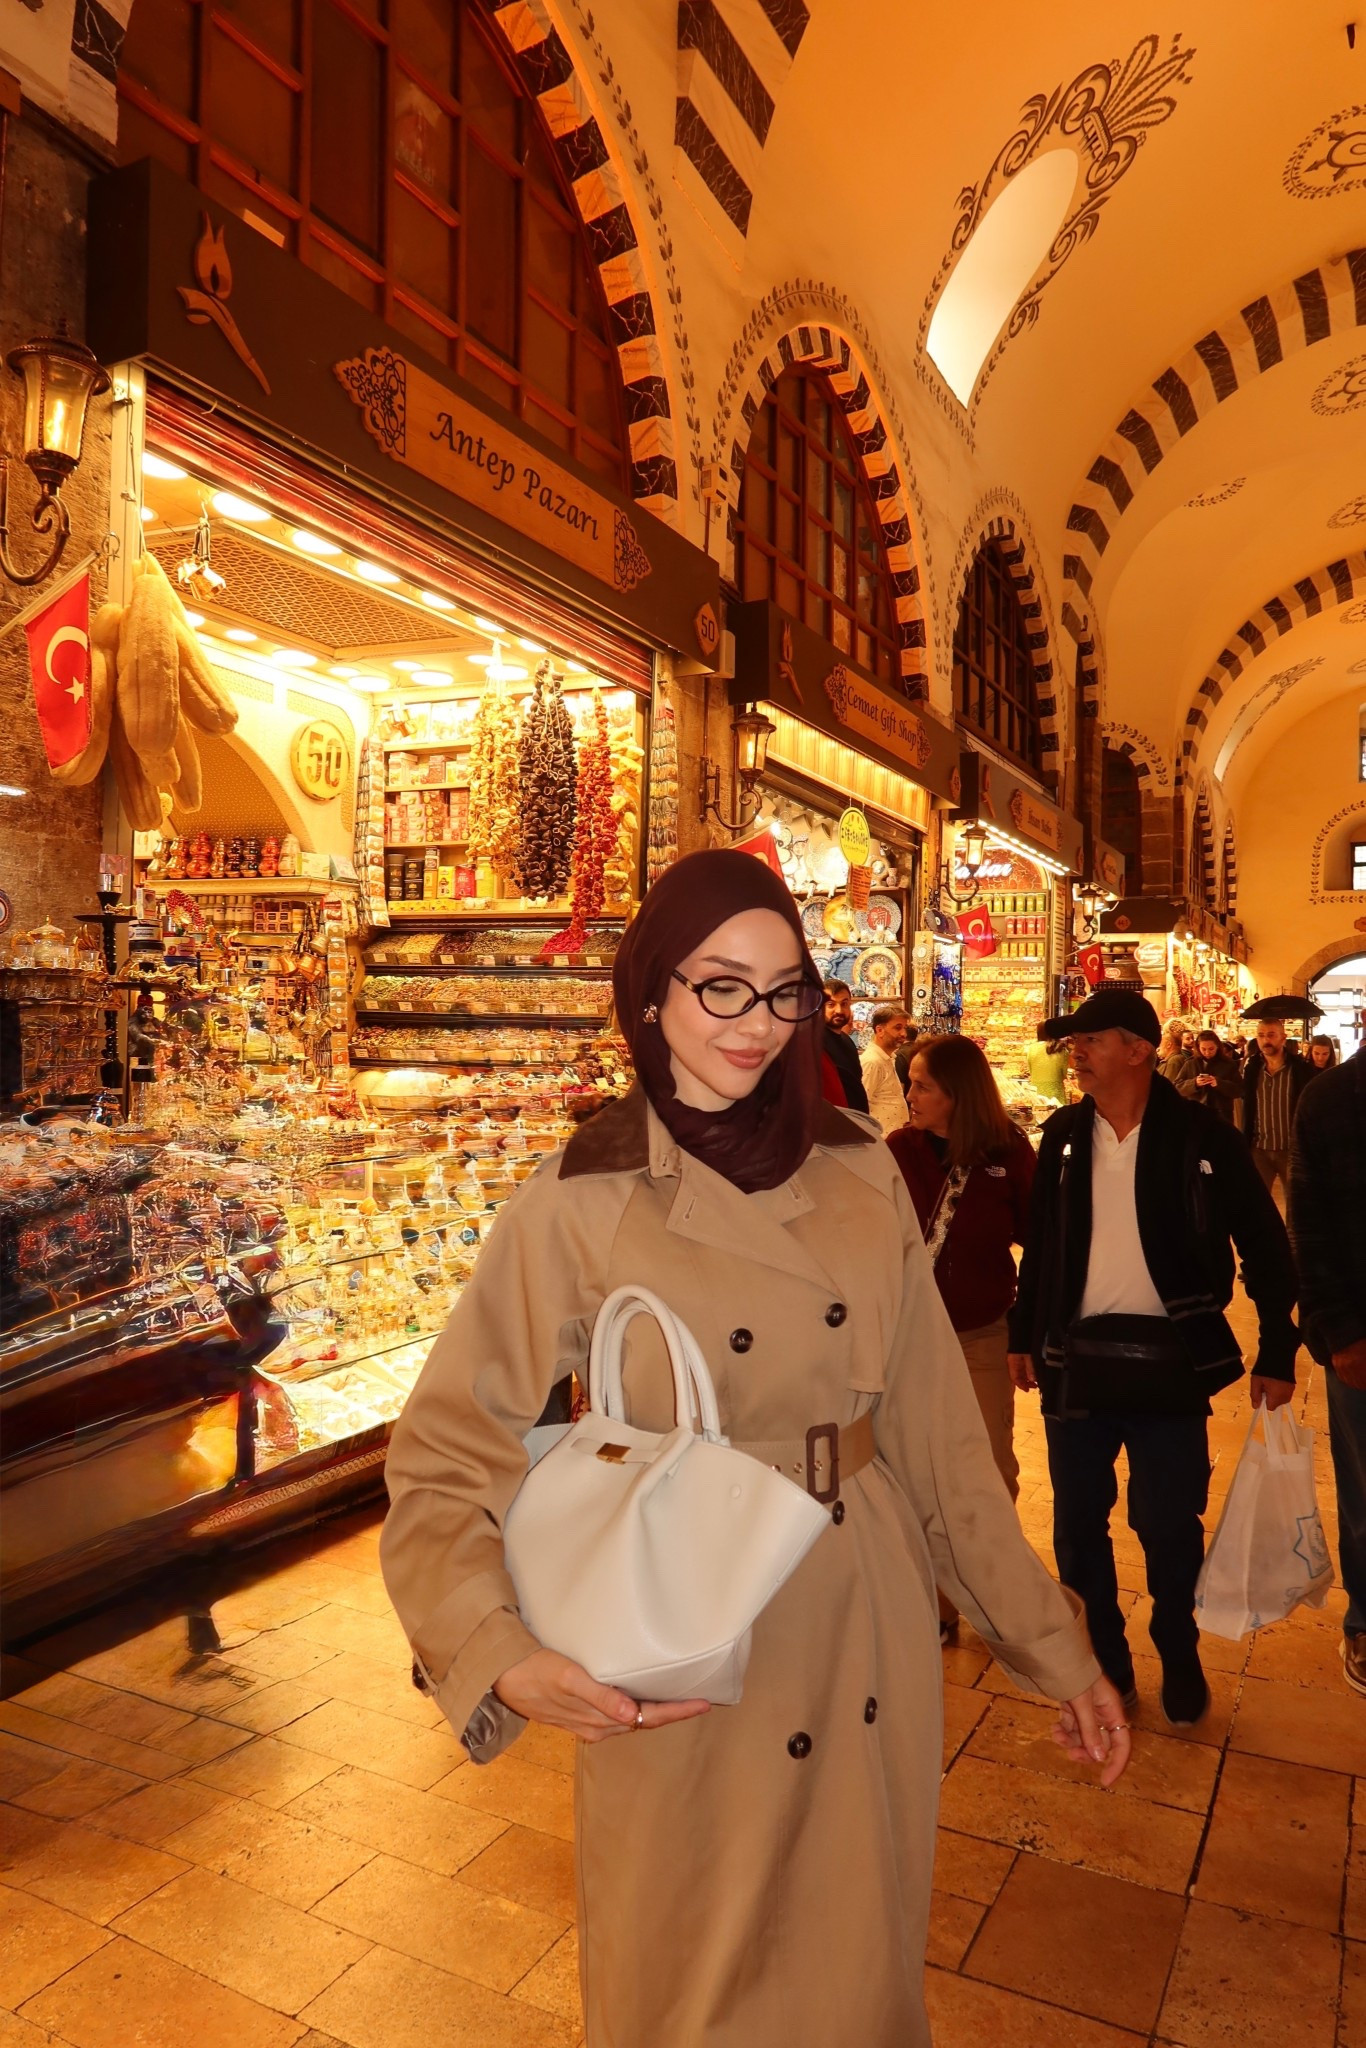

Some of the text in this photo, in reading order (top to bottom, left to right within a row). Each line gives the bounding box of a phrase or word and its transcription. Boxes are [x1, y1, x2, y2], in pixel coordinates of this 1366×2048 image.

[429, 411, 599, 541] Antep Pazarı
[701, 613, 715, 643] 50
[847, 685, 917, 752] Cennet Gift Shop
[306, 730, 342, 788] 50
